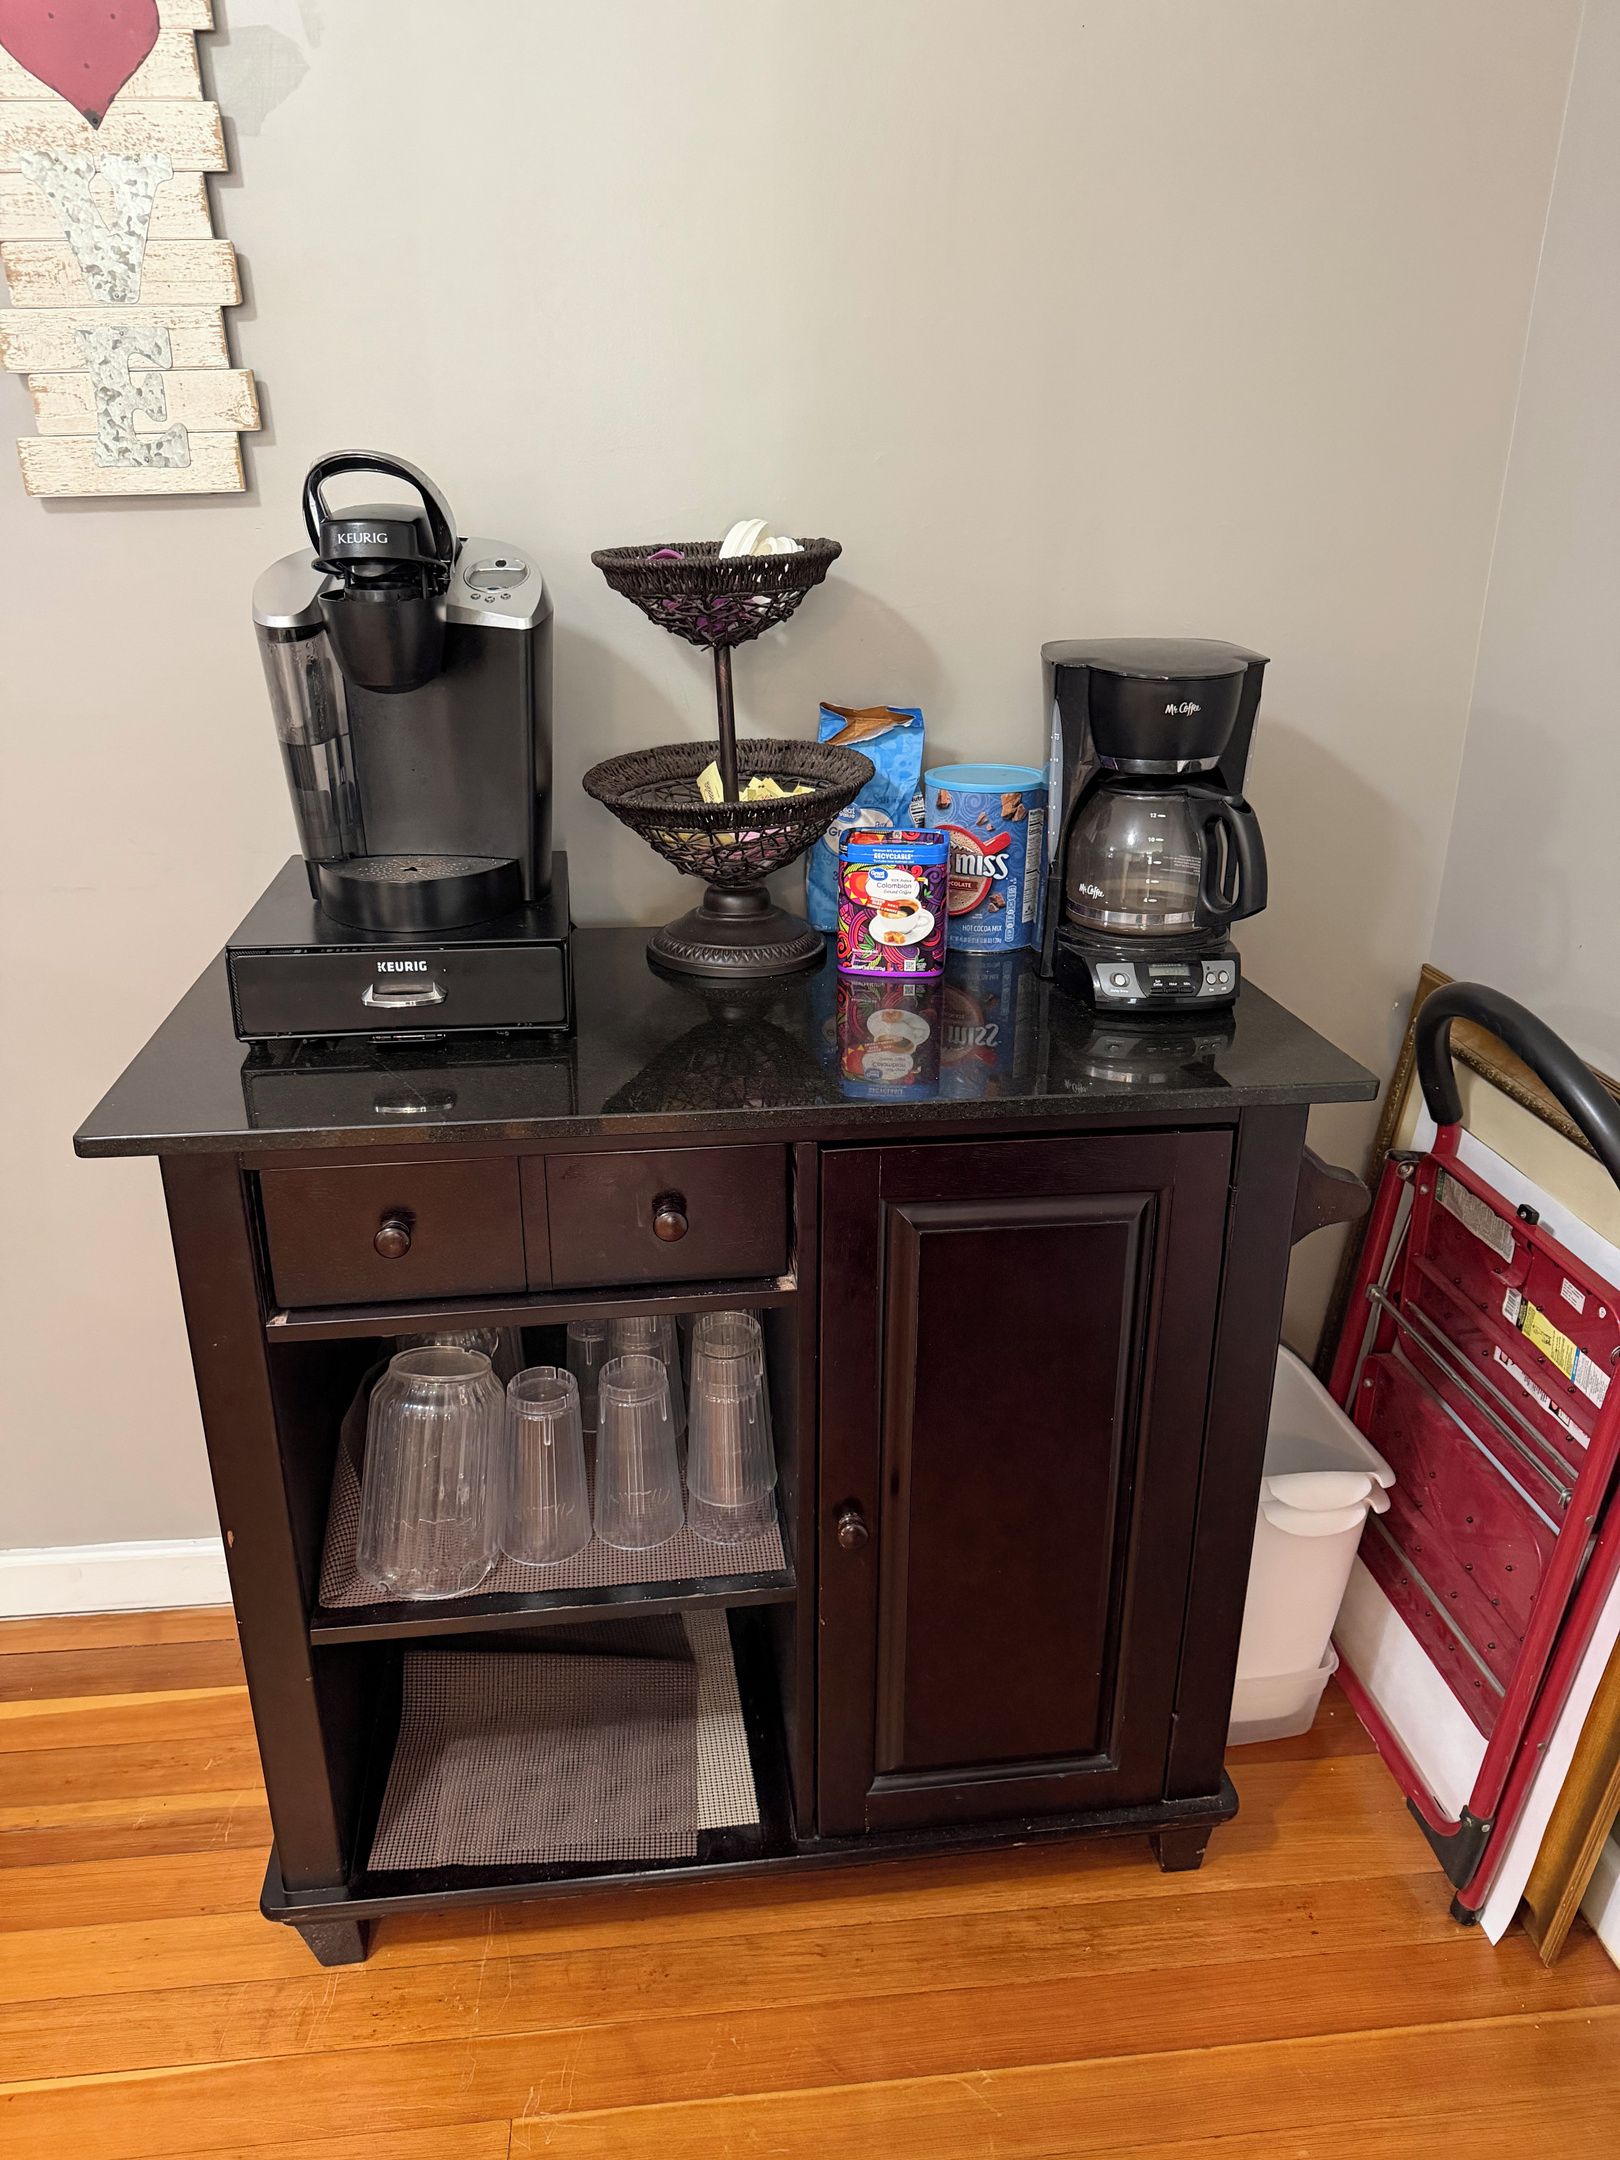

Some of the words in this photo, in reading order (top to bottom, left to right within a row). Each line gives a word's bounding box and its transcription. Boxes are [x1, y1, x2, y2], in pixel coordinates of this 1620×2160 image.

[337, 532, 388, 545] KEURIG
[1178, 701, 1202, 717] Coffee
[948, 880, 972, 888] COLATE
[1087, 884, 1105, 899] Coffee
[376, 960, 428, 972] KEURIG
